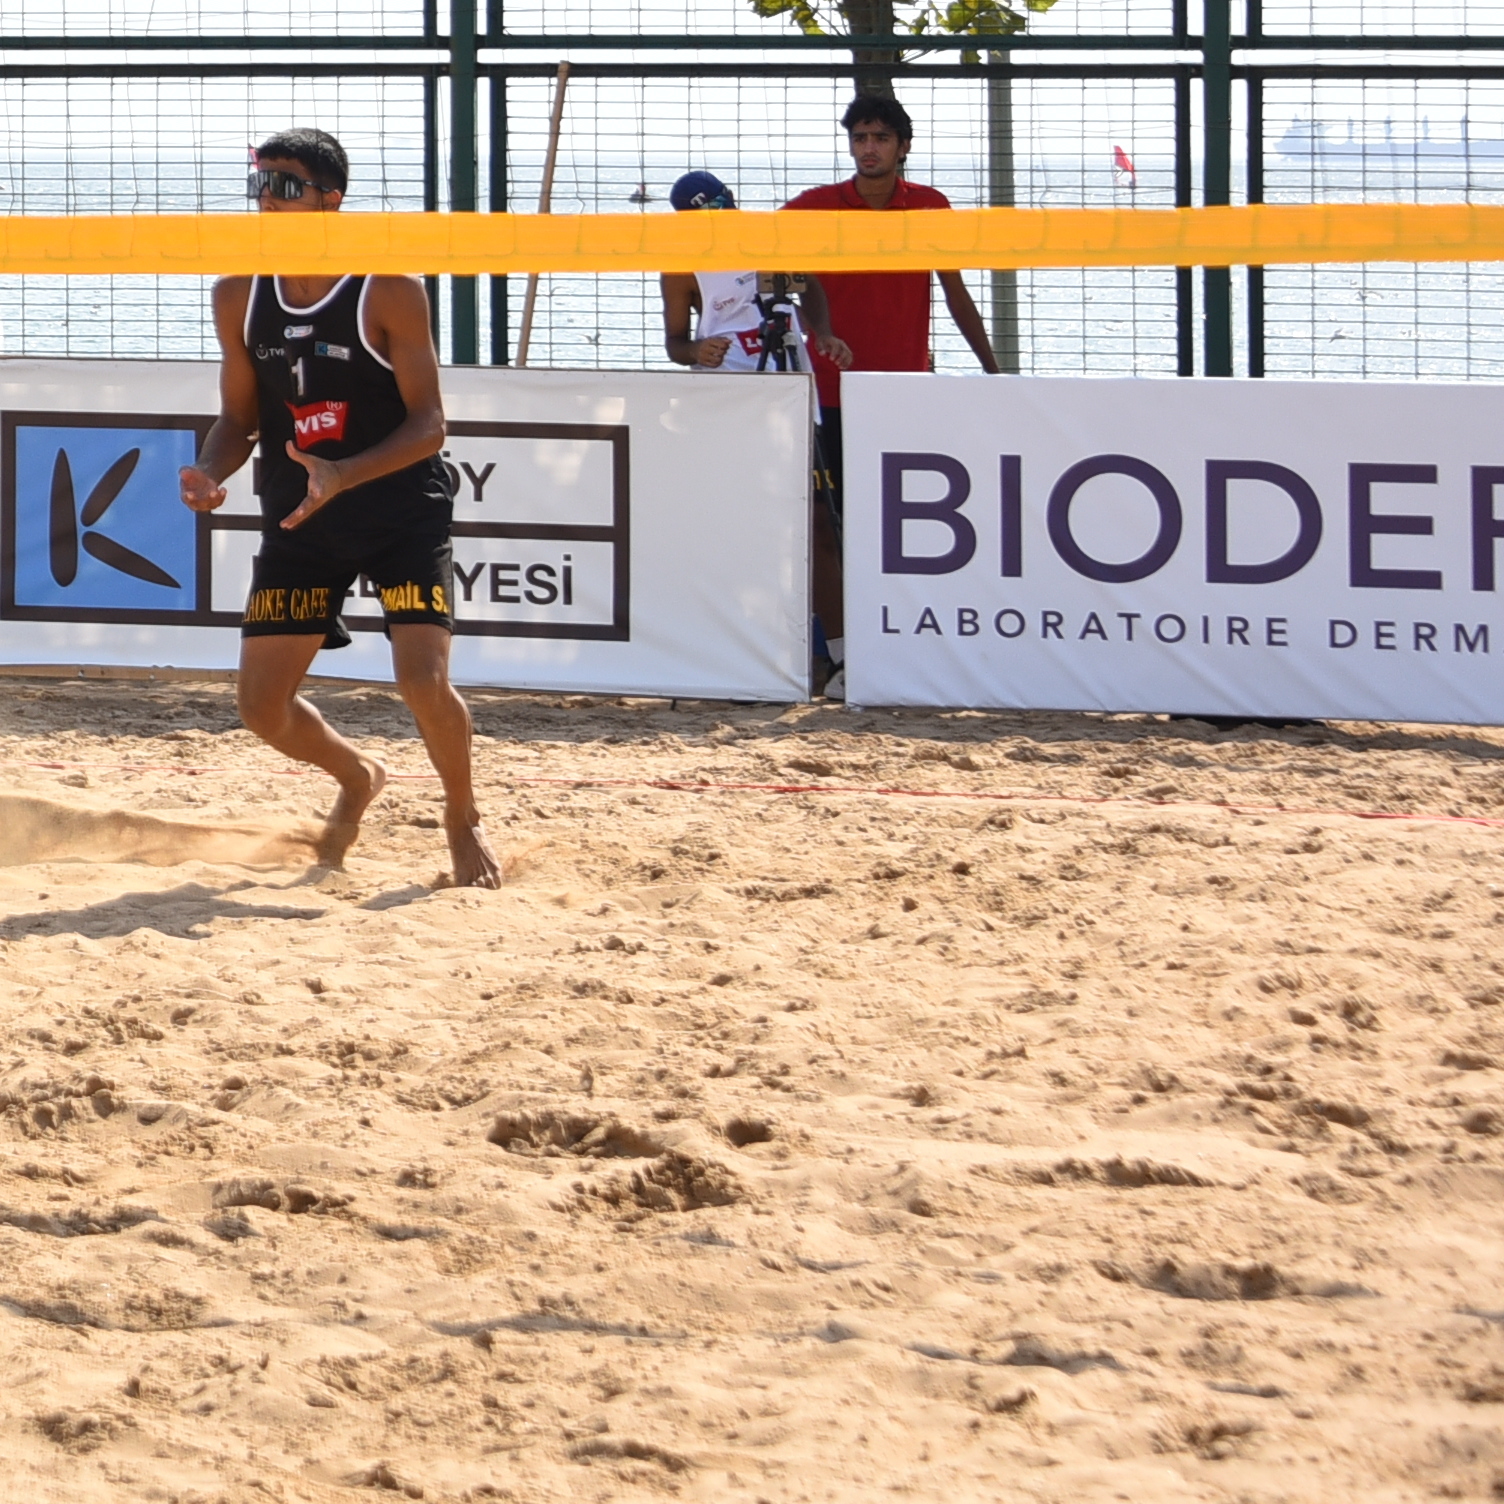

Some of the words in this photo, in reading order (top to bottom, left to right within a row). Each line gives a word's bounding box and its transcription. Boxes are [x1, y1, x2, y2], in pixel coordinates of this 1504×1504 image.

[291, 357, 304, 396] 1
[291, 588, 329, 619] CAFE
[881, 604, 1290, 649] LABORATOIRE
[1328, 618, 1504, 654] DERM
